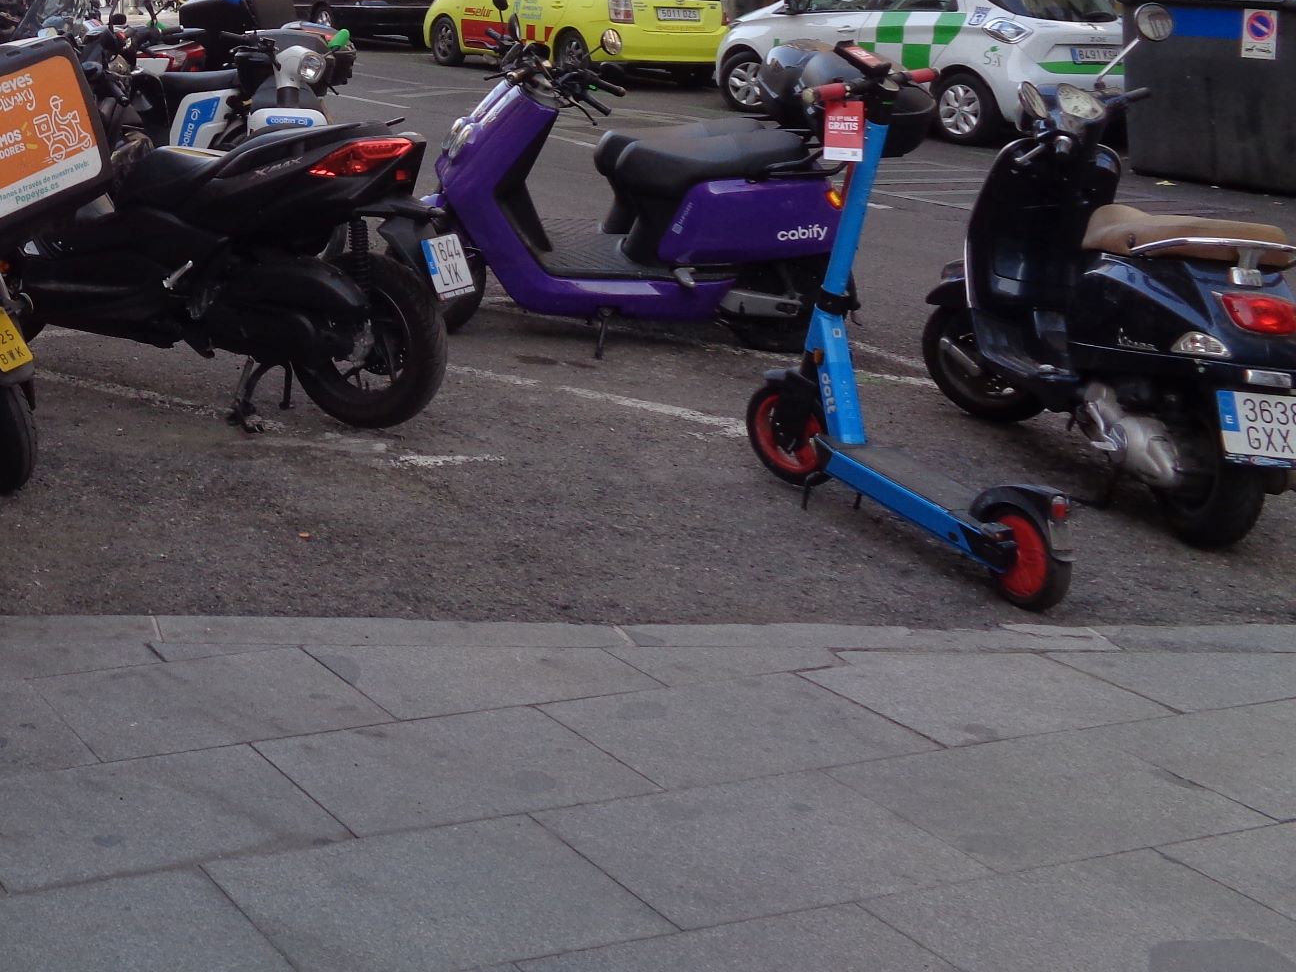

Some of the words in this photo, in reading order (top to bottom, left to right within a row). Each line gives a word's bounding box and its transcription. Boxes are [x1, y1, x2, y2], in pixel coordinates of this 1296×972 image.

[661, 9, 680, 18] 5011
[1078, 48, 1102, 59] 8491
[828, 122, 859, 131] GRATIS
[42, 175, 51, 185] de
[51, 167, 74, 181] nuestra
[74, 160, 90, 172] Web:
[15, 181, 60, 205] Popeyes.es
[777, 224, 828, 241] cabify
[437, 263, 463, 286] LYK
[821, 371, 836, 414] dott
[1246, 426, 1295, 454] GXX
